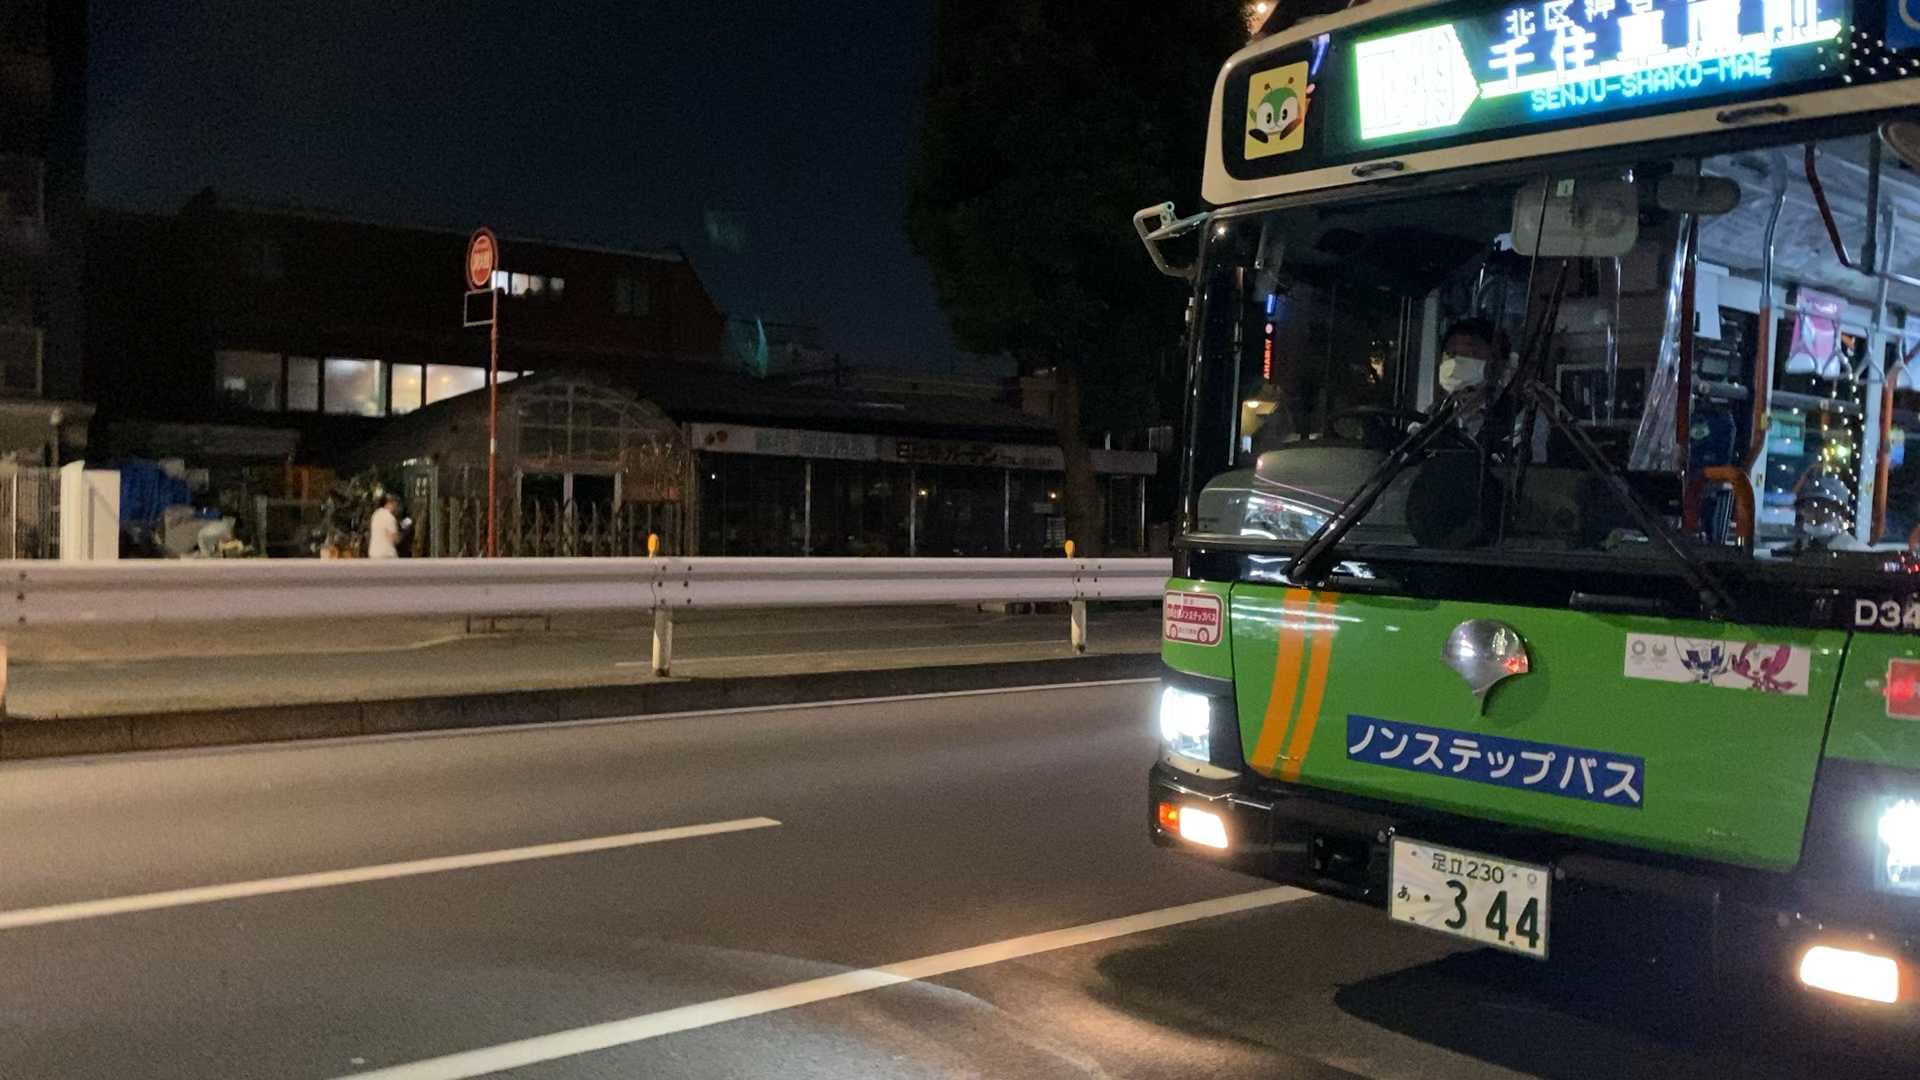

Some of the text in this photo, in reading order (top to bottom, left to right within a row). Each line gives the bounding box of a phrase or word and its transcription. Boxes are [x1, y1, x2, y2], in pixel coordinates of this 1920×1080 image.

[1530, 51, 1773, 112] SENJU-SHAKO-MAE
[1349, 724, 1641, 803] ノンステップバス
[1397, 885, 1411, 902] あ
